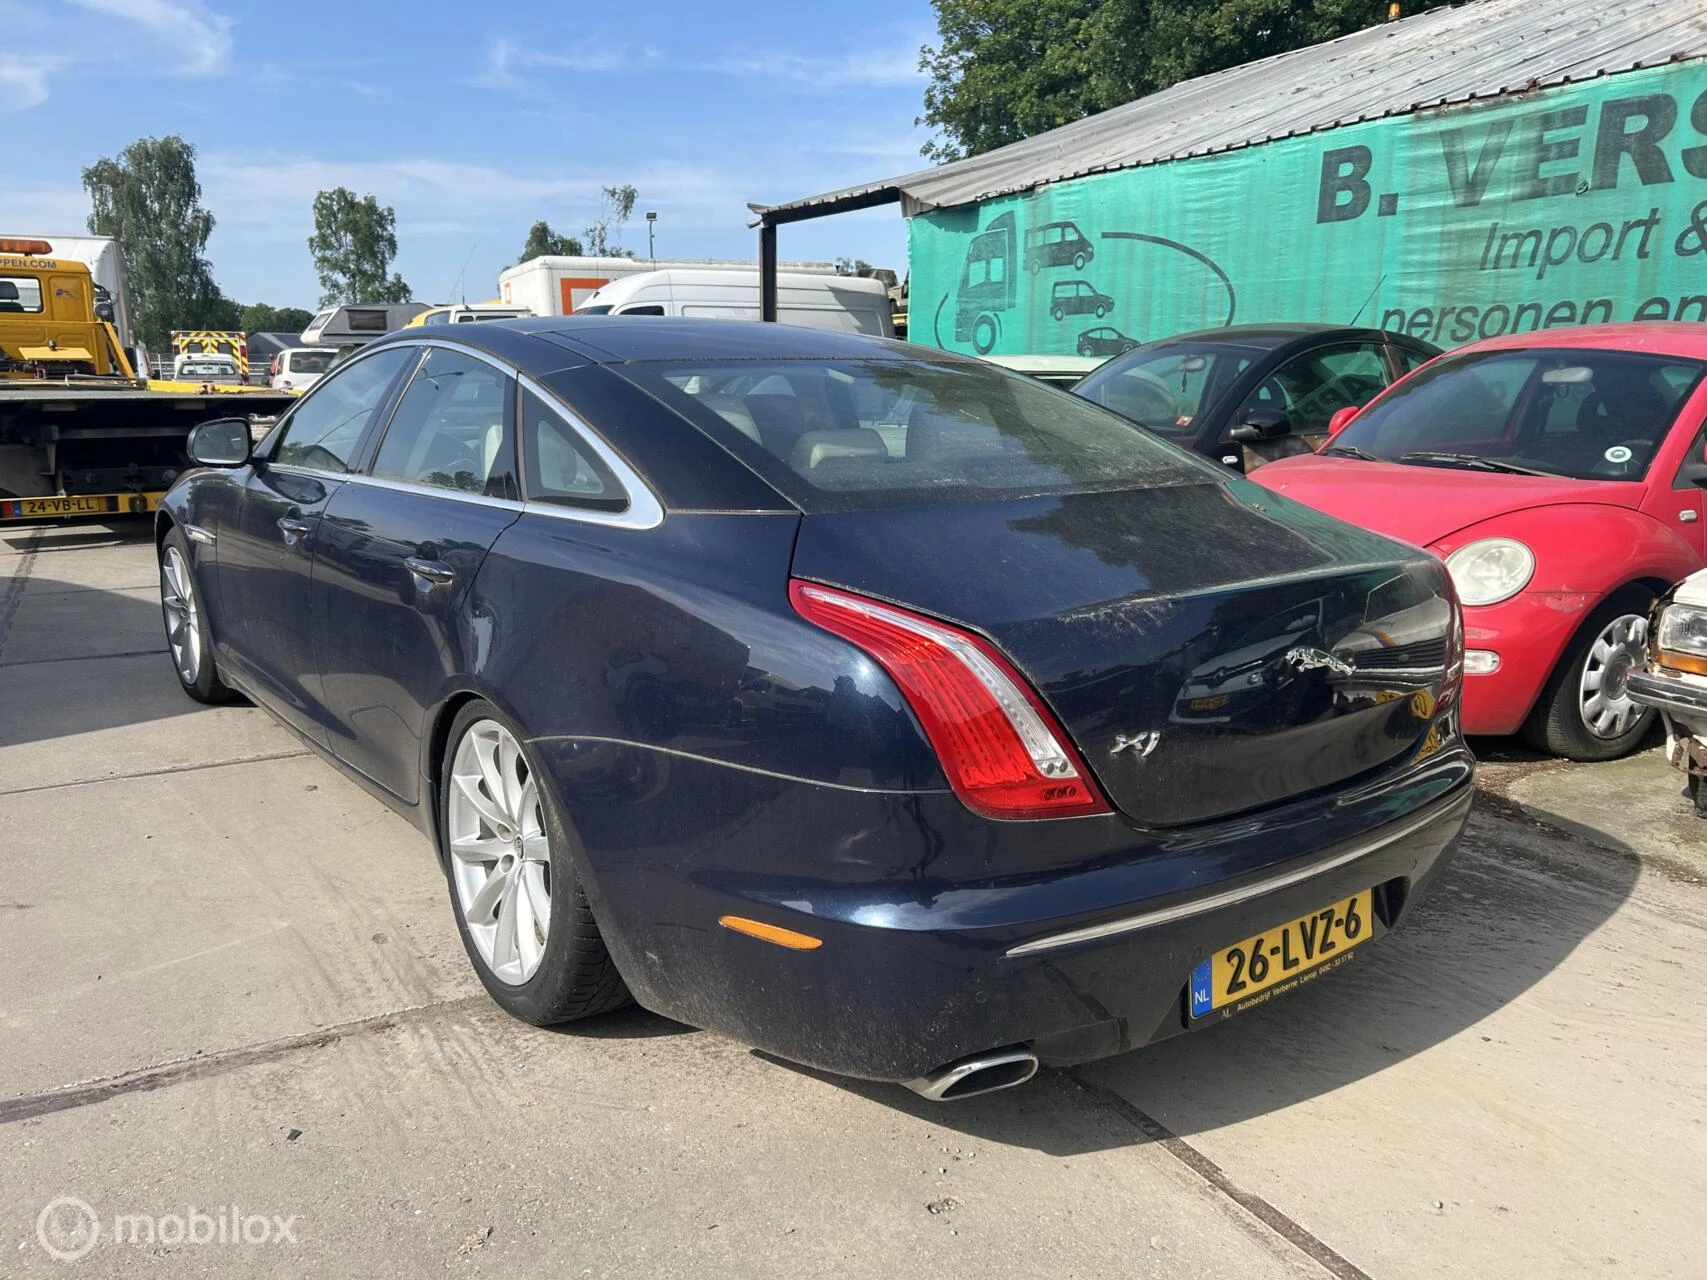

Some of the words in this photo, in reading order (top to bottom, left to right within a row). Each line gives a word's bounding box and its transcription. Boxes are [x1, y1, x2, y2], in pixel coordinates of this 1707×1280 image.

[1316, 144, 1399, 224] B.
[1478, 207, 1661, 280] Import
[0, 258, 57, 269] PEN.COM
[28, 499, 94, 513] 24-VB-LL
[1111, 731, 1160, 757] XJ
[1226, 898, 1361, 995] 26-LVZ-6
[1194, 988, 1210, 1005] NL
[1237, 991, 1271, 1012] Autobedrijf
[1272, 980, 1298, 996] Verberne
